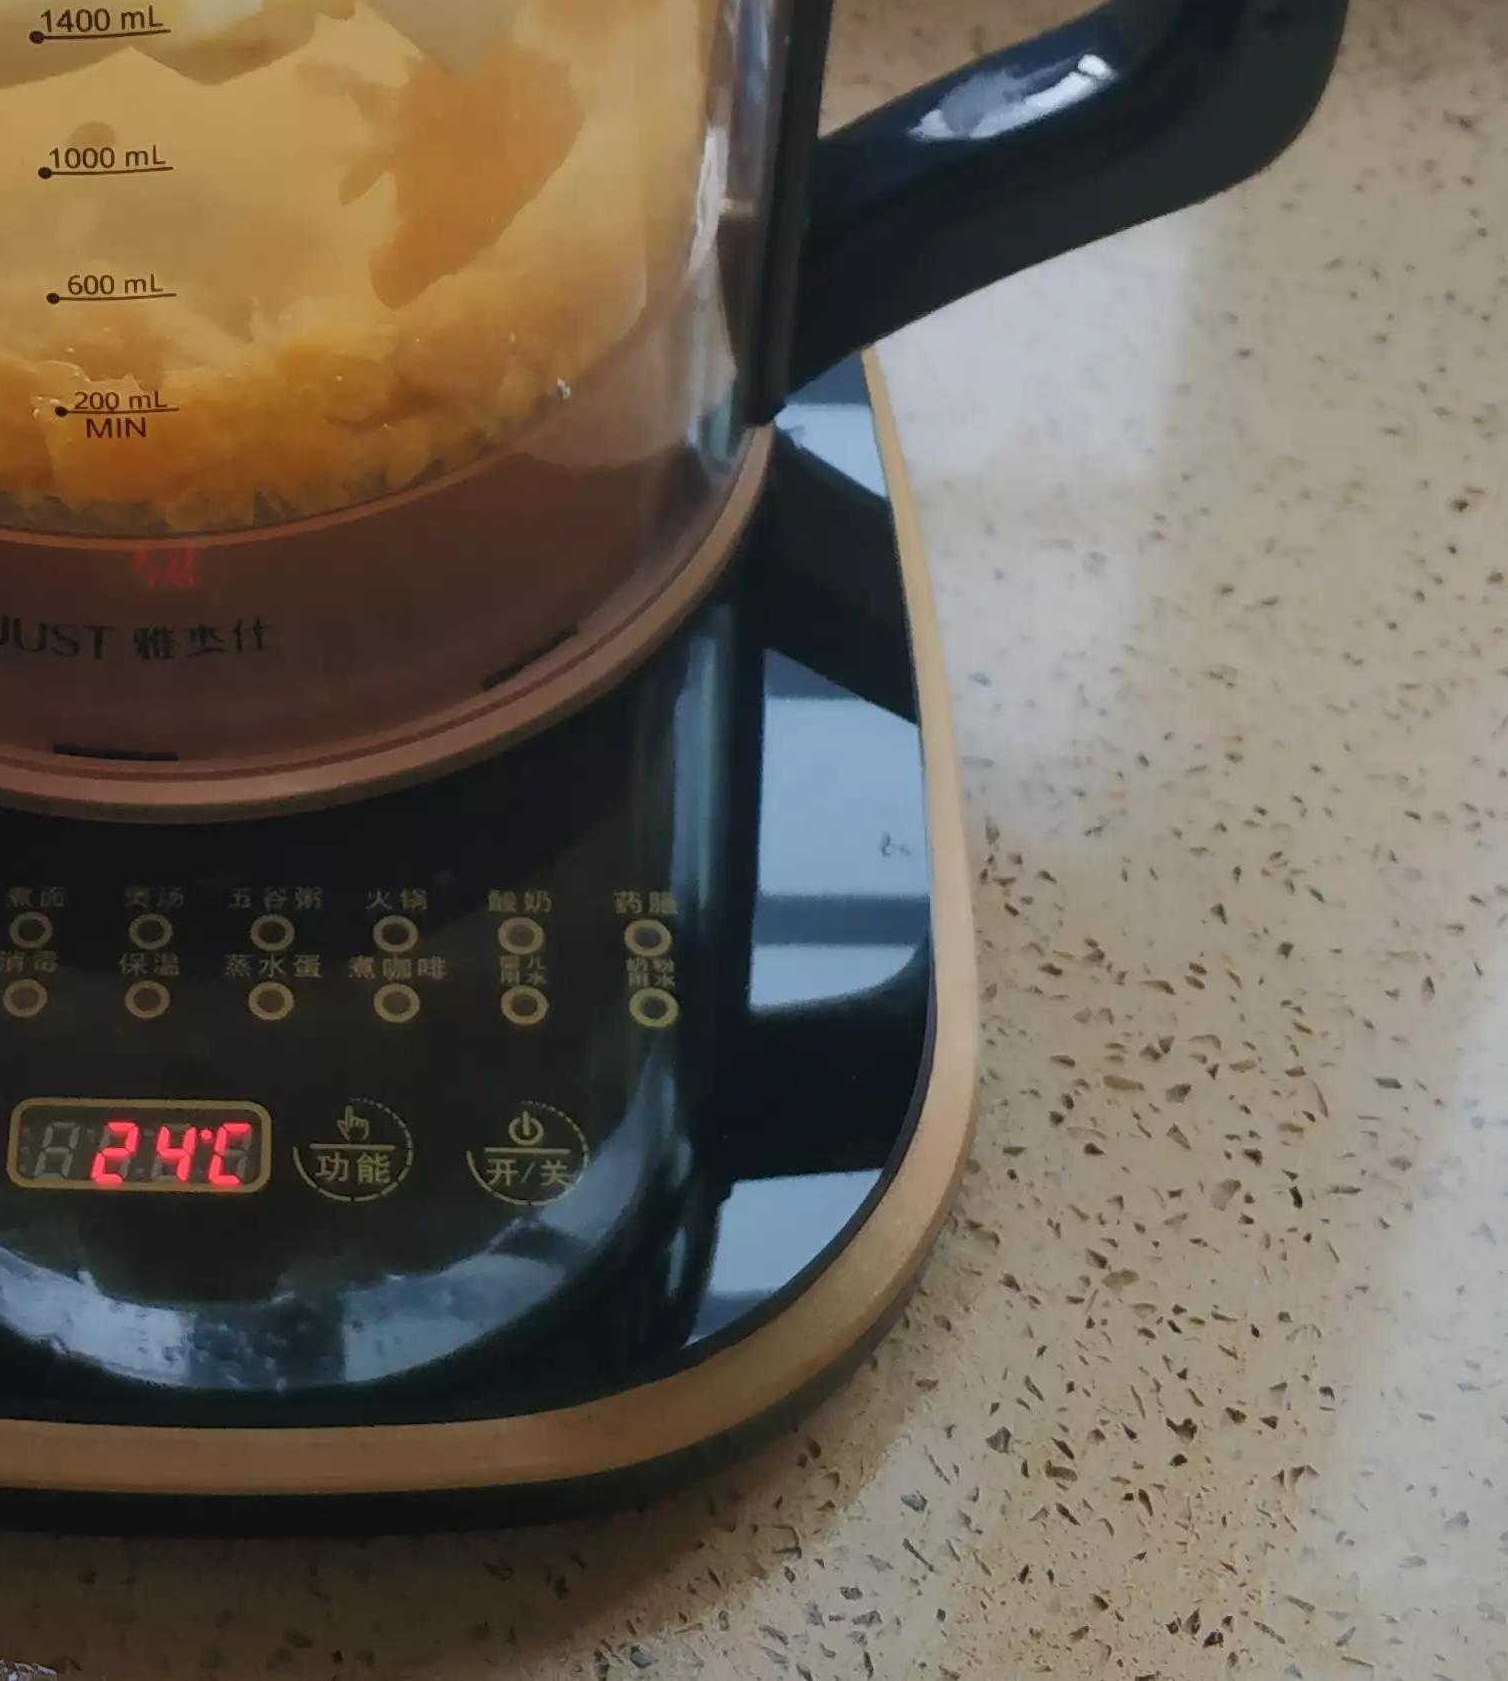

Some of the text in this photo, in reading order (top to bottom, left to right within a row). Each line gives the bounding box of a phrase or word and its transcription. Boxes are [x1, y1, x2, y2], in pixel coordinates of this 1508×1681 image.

[41, 5, 163, 33] 1400 mL
[49, 144, 167, 169] 1000 mL
[67, 273, 164, 296] 600 mL
[74, 390, 167, 411] 200 mL
[86, 417, 147, 438] MIN
[228, 886, 324, 910] 五谷粥
[366, 888, 429, 911] 火锅
[119, 952, 181, 977] 保温
[225, 953, 323, 978] 蒸水蛋
[348, 954, 448, 980] 煮咖啡
[315, 1151, 391, 1185] 功能
[486, 1158, 572, 1187] 开/关
